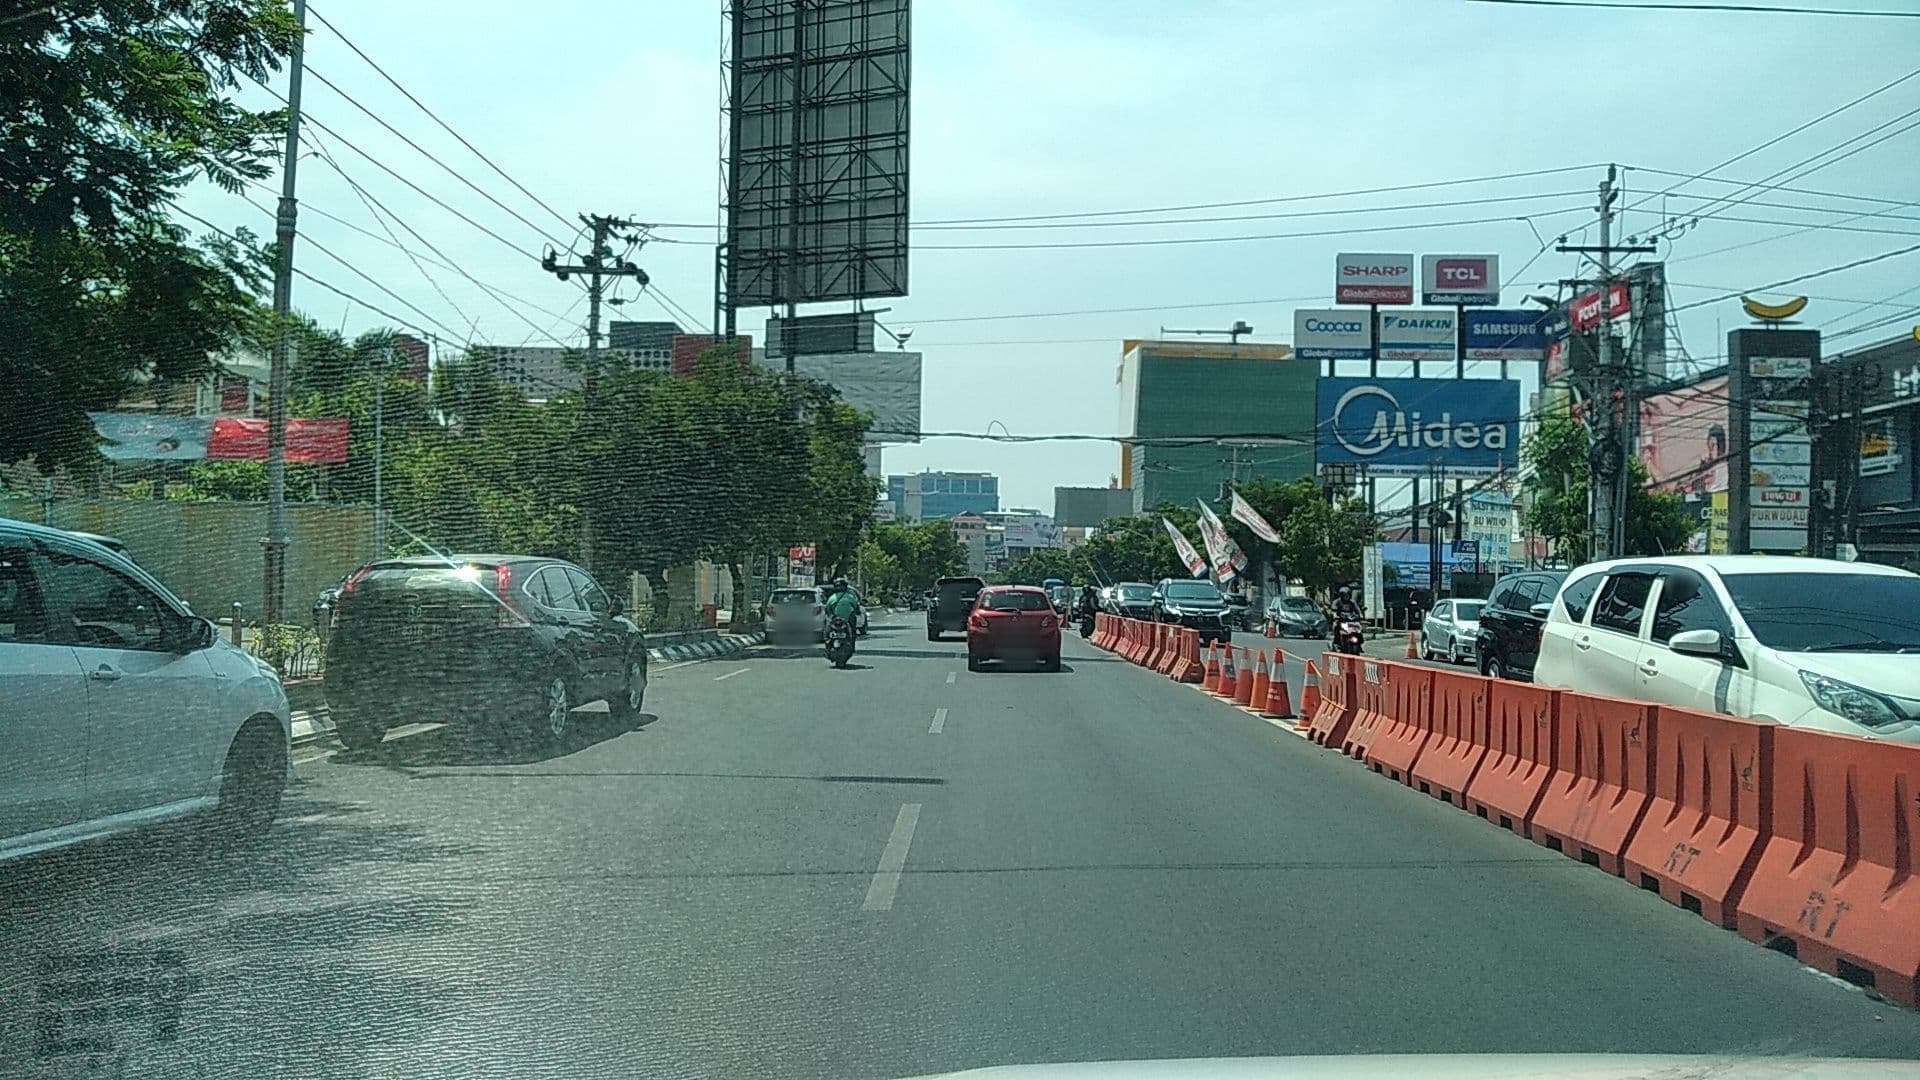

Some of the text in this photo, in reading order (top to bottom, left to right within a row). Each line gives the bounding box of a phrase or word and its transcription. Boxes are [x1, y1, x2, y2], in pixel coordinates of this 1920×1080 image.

[1342, 265, 1408, 277] SHARP
[1442, 267, 1481, 281] TCL
[1397, 319, 1452, 329] DAIKIN
[1473, 323, 1537, 335] SAMSUNG
[1362, 409, 1508, 450] Midea
[1751, 509, 1808, 521] PURWODAD
